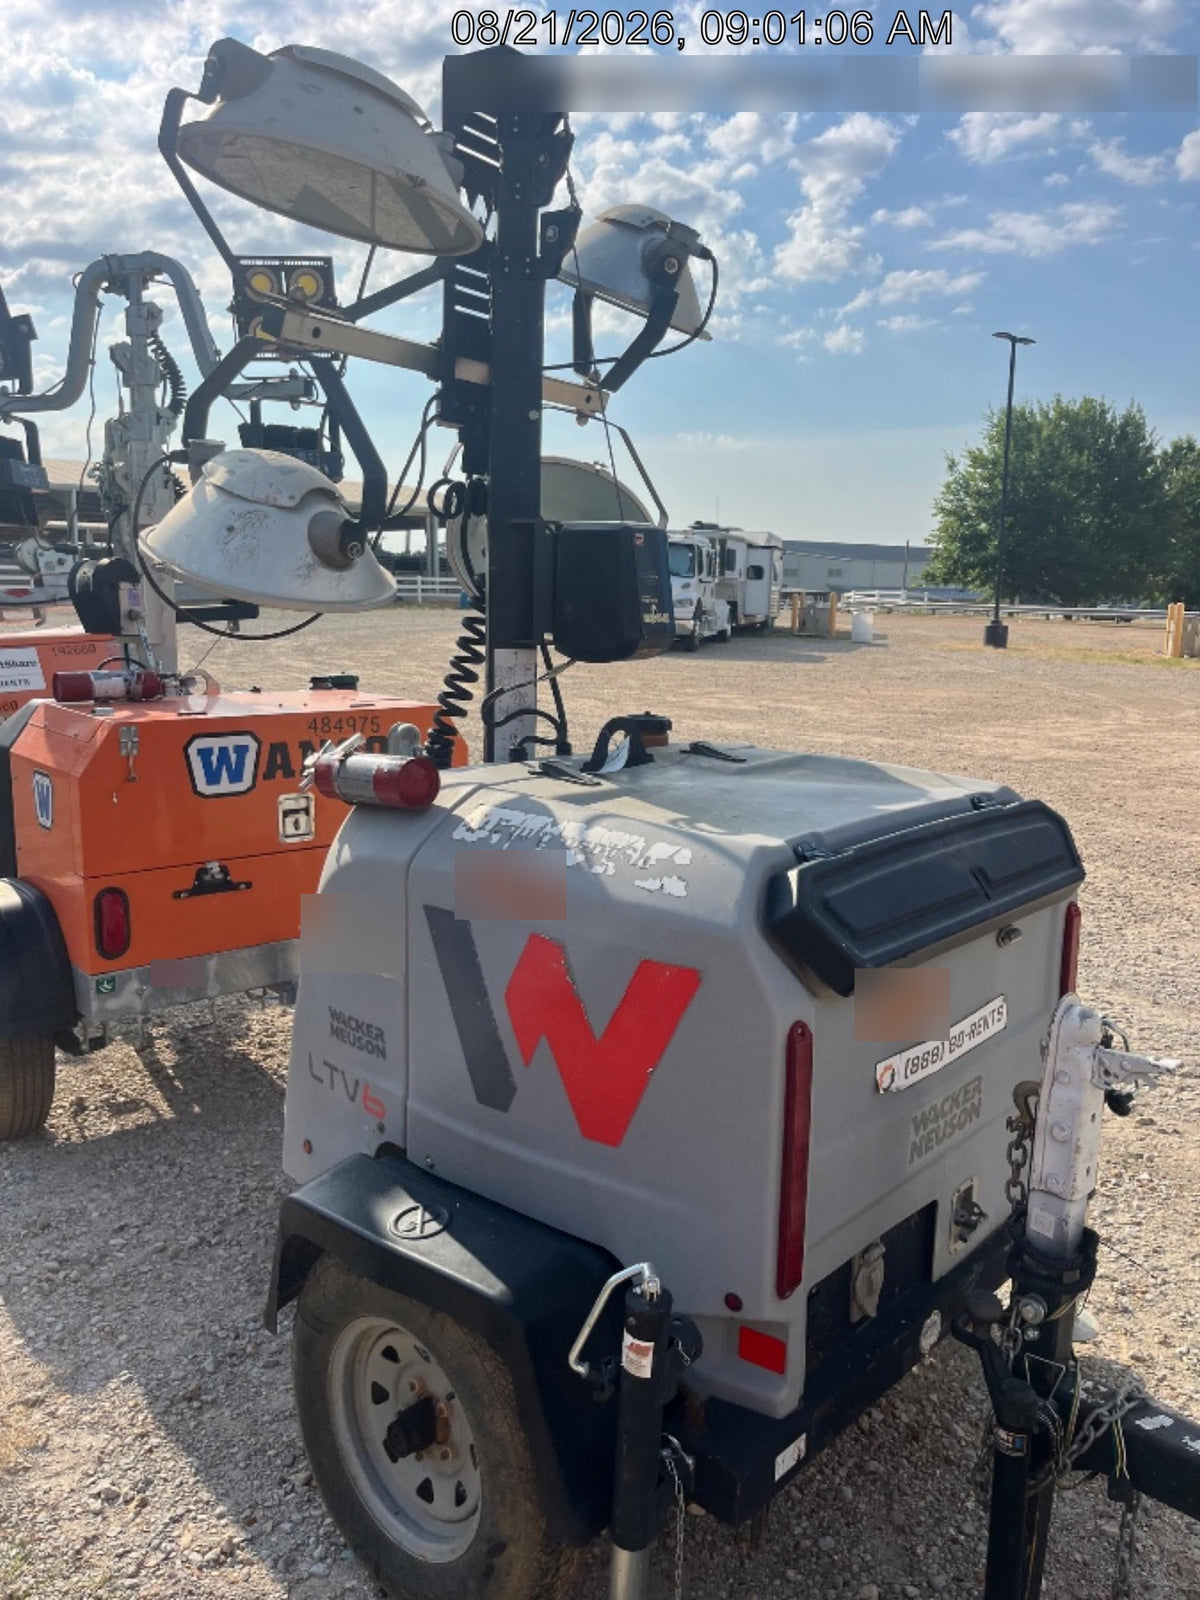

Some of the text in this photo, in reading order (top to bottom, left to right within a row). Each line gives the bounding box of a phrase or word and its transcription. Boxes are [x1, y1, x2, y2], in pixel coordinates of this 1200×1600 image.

[308, 716, 380, 734] 484975
[328, 1005, 386, 1044] WACKER
[329, 1022, 387, 1061] NEUSON
[904, 1042, 945, 1079] (888)
[308, 1051, 387, 1120] LTV6
[911, 1074, 983, 1136] WACKER
[908, 1097, 982, 1165] NEUSON
